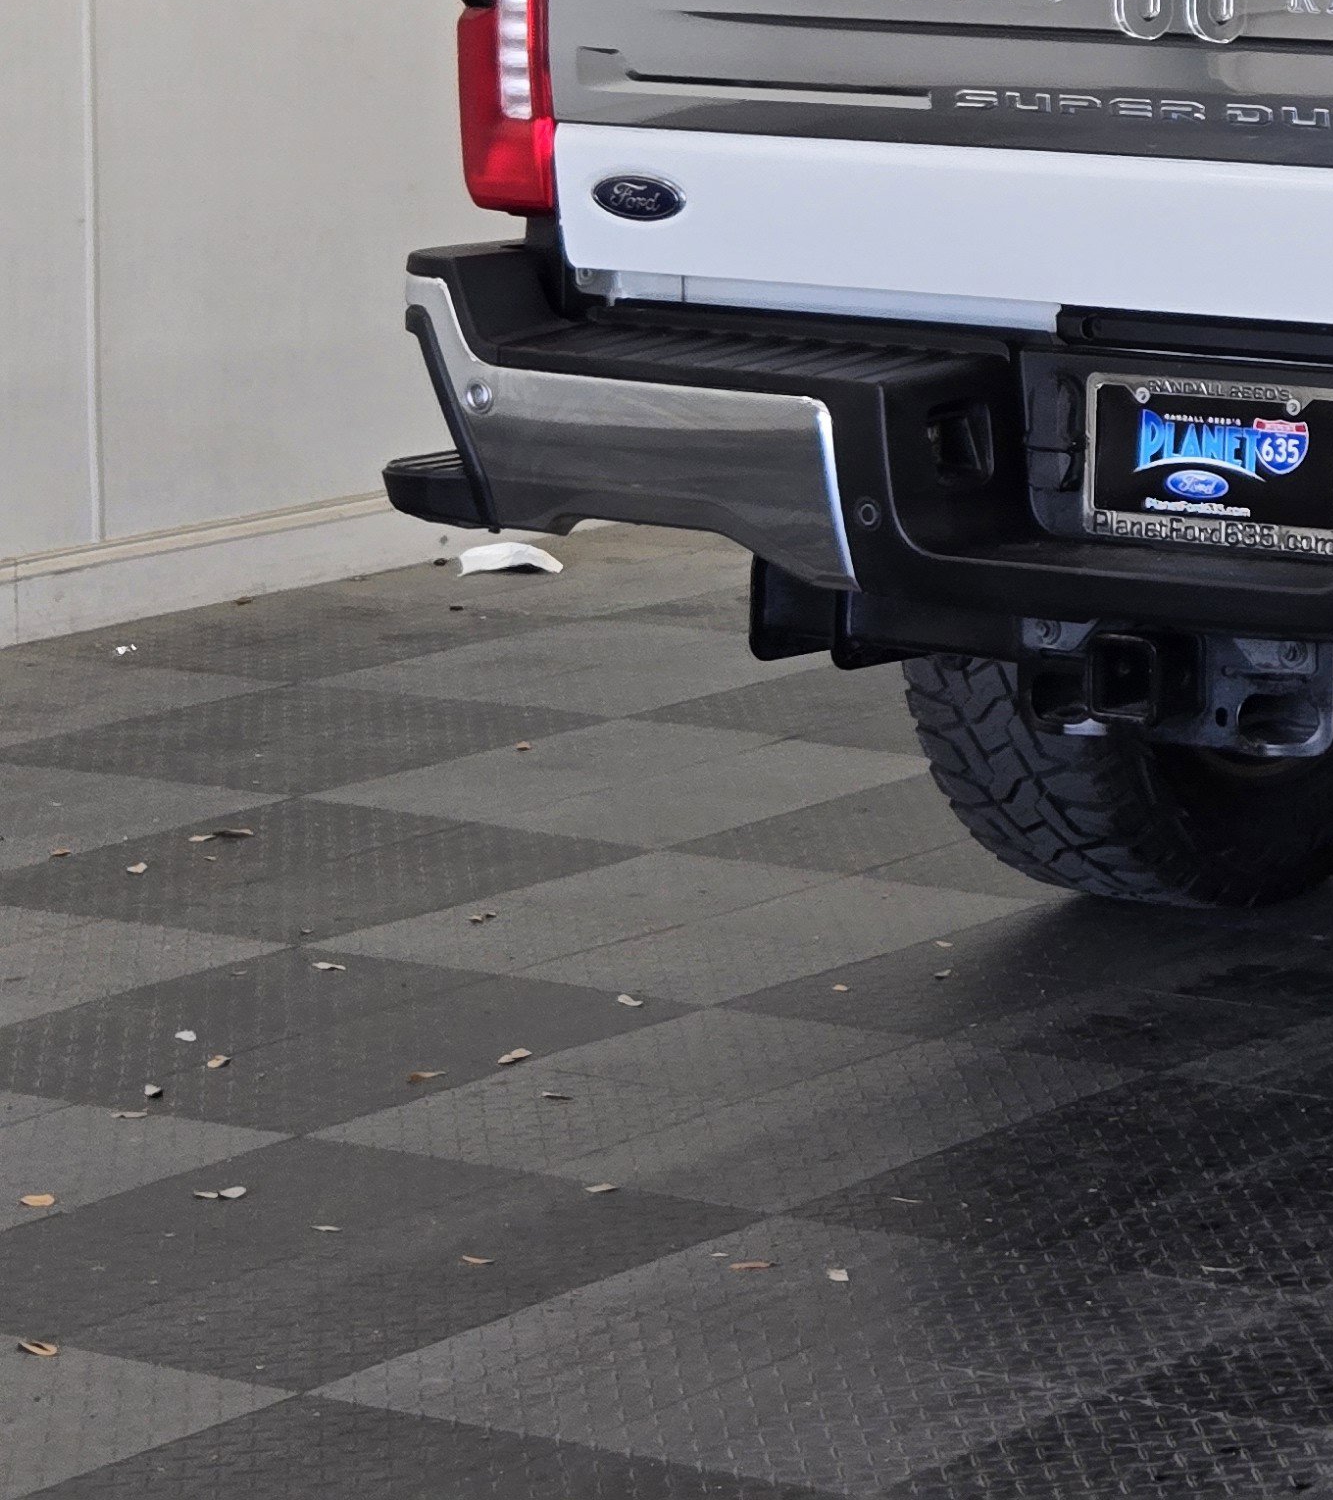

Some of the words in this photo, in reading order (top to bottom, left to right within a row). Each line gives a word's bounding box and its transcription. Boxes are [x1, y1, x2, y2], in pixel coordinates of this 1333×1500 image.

[953, 88, 1206, 122] SUPER
[609, 181, 663, 212] Ford
[1148, 379, 1226, 397] RANDALL
[1230, 385, 1293, 402] REED'S
[1138, 408, 1262, 474] PLANET
[1260, 436, 1301, 465] 635
[1177, 473, 1217, 496] Ford
